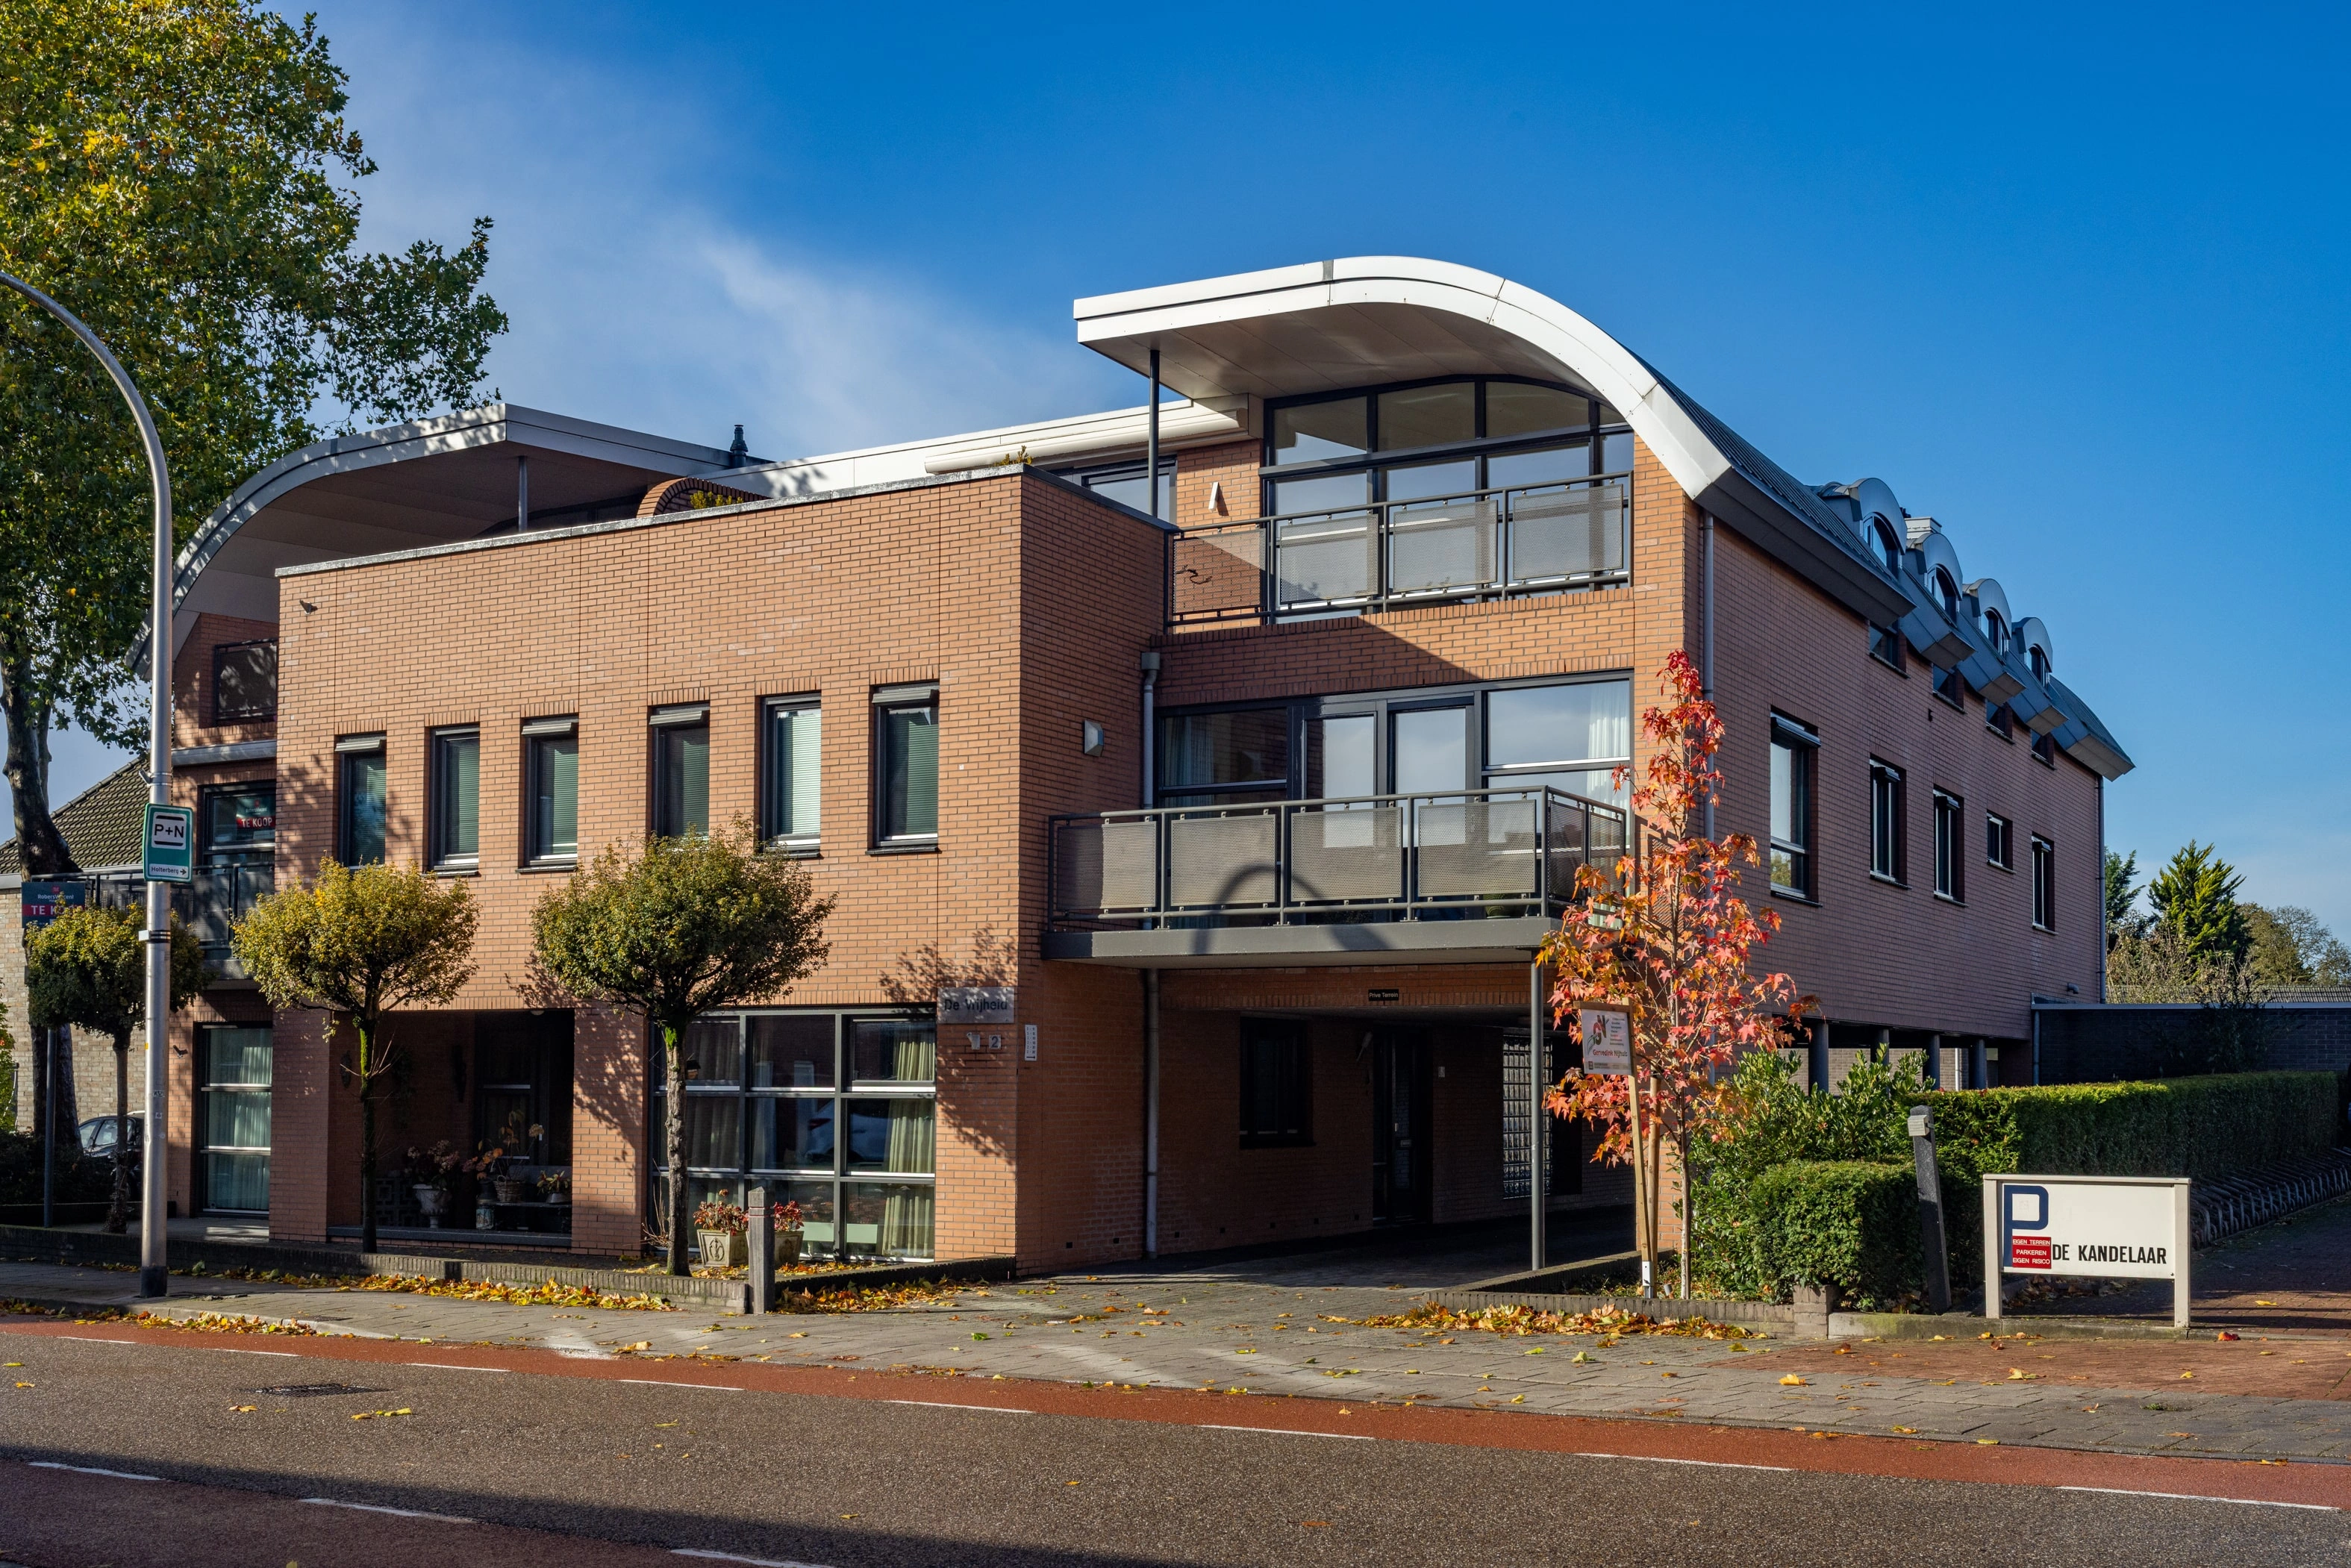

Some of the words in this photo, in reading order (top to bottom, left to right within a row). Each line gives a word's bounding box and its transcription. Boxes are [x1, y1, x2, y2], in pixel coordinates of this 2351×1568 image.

[242, 819, 251, 828] TE
[252, 817, 272, 827] KOOP
[154, 824, 184, 838] P+N
[151, 866, 179, 875] Holterberg
[31, 905, 46, 915] TE
[944, 999, 960, 1010] De
[965, 998, 1008, 1013] Vrijheid
[2003, 1184, 2049, 1267] P
[2052, 1244, 2070, 1261] DE
[2079, 1245, 2167, 1264] KANDELAAR
